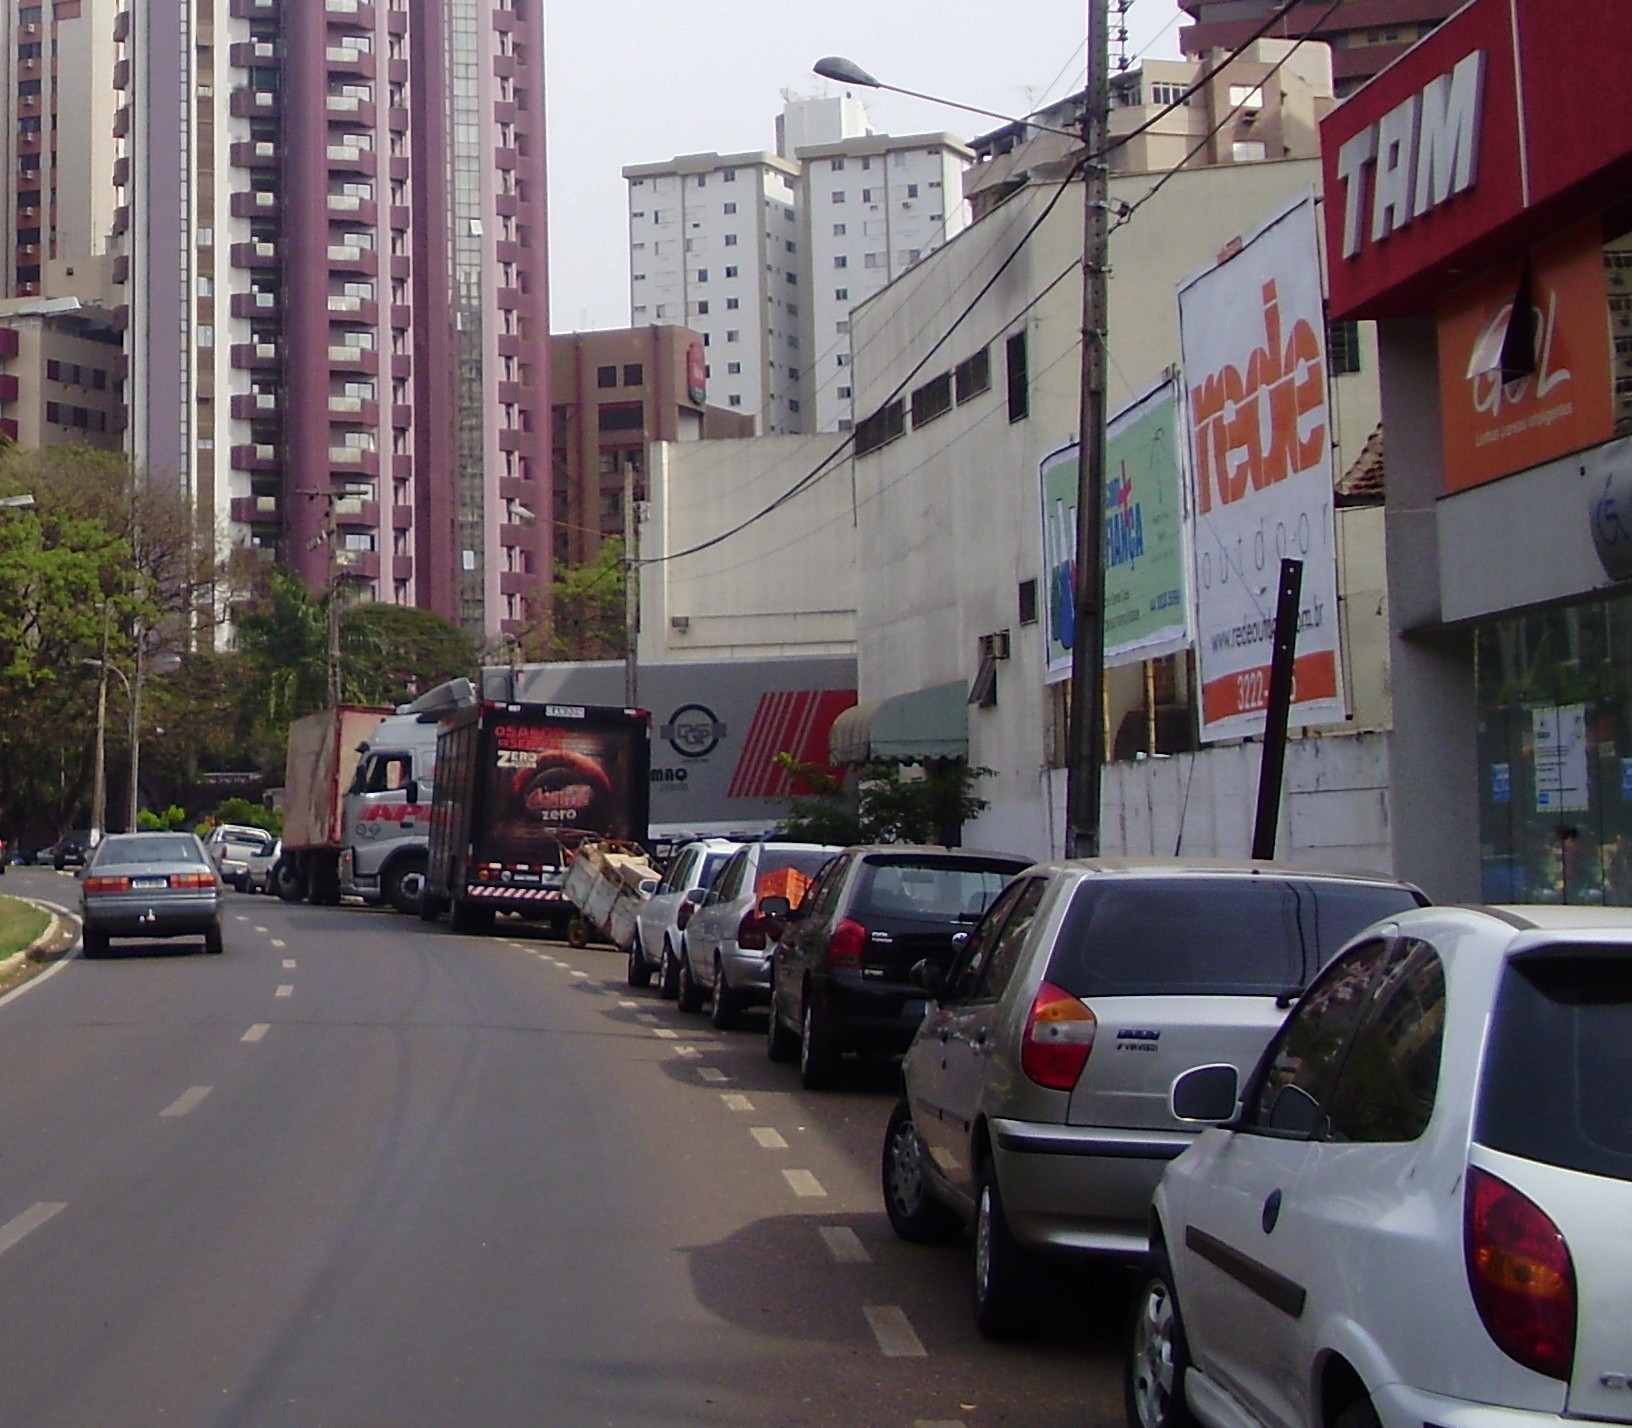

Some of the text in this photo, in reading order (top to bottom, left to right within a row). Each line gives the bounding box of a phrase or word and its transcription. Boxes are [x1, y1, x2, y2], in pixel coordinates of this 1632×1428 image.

[1337, 50, 1485, 259] TAM
[1190, 278, 1324, 515] rede
[1237, 664, 1297, 711] 3222-
[541, 809, 577, 821] zero
